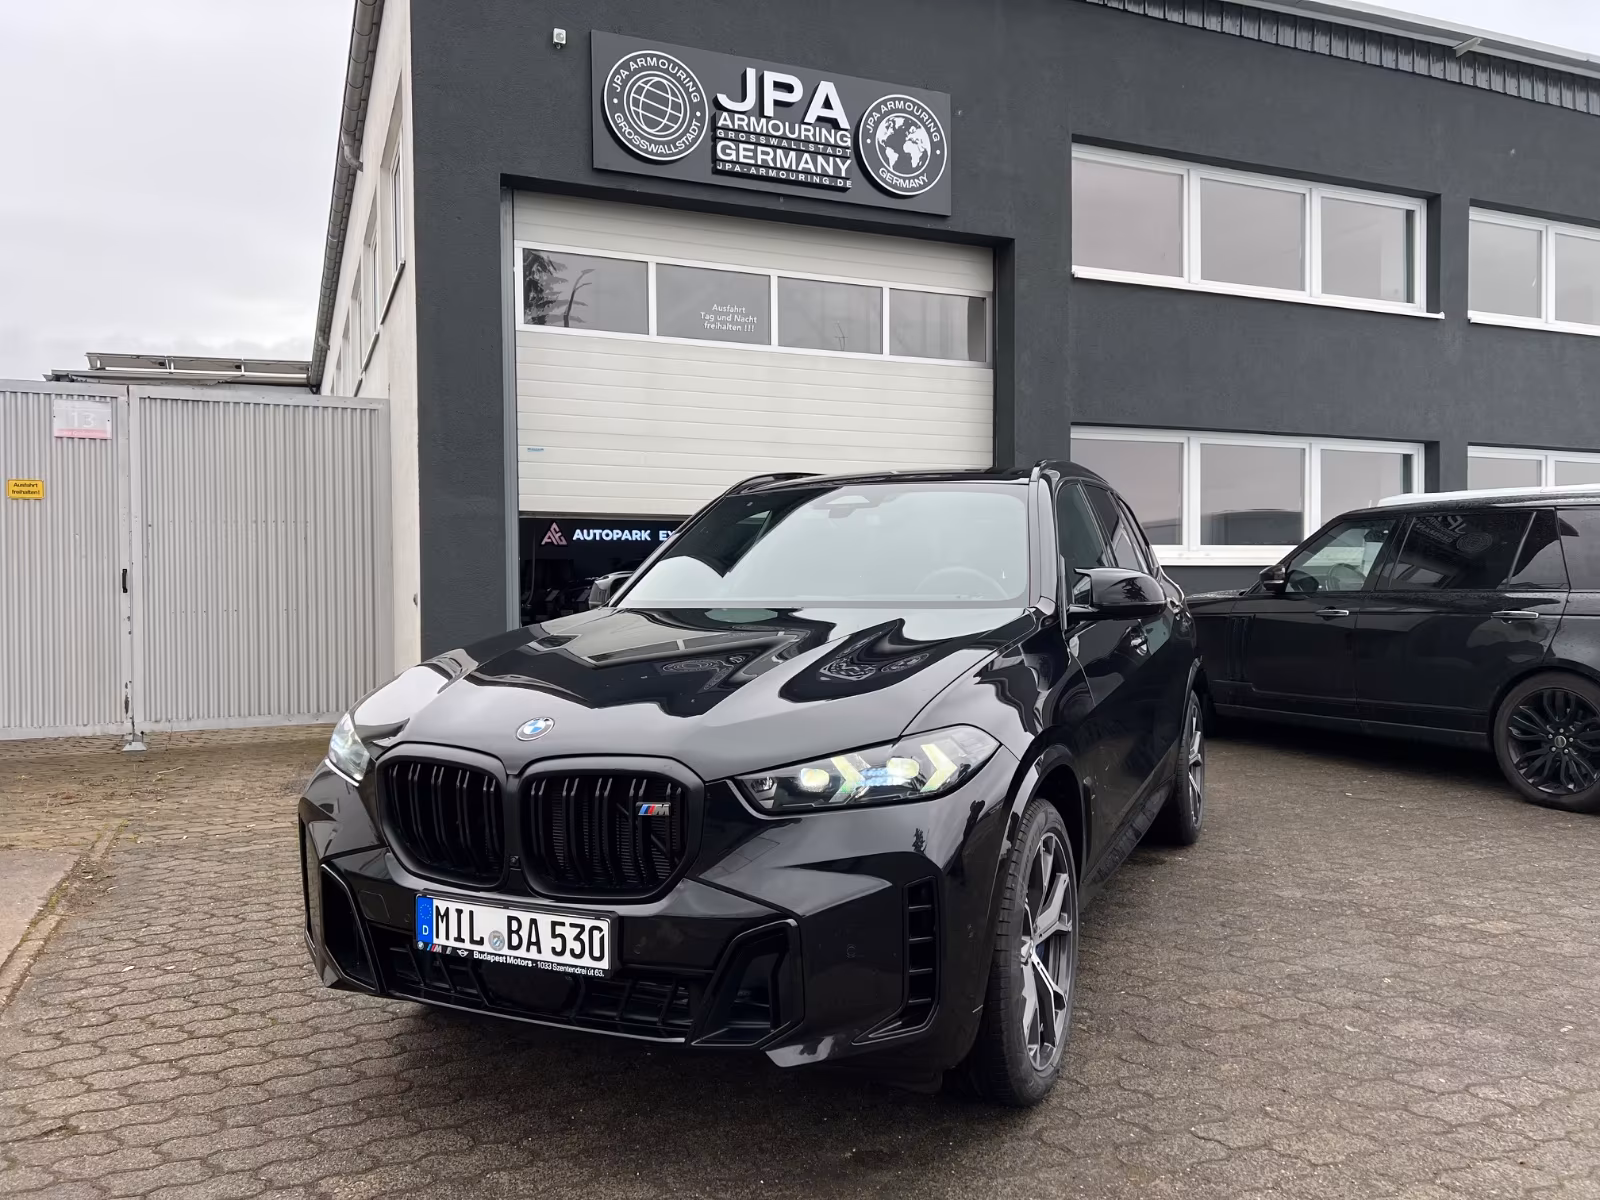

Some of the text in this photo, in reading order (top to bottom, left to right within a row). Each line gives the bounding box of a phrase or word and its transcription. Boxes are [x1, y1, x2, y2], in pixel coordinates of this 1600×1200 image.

[611, 56, 701, 103] JPA ARMOURING
[716, 67, 851, 130] JPA
[613, 111, 702, 154] GROSSWALLSTADT
[716, 111, 852, 147] ARMOURING
[866, 99, 941, 143] JPA ARMOURING
[716, 129, 852, 157] GROSSWALLSTADT
[716, 140, 852, 177] GERMANY
[716, 161, 853, 188] JPA-ARMOURING.DE
[878, 166, 929, 189] GERMANY
[700, 311, 757, 323] Tag und Nacht
[712, 303, 746, 314] Ausfahrt
[703, 321, 755, 332] freihalten !!!
[572, 529, 652, 541] AUTOPARK
[422, 925, 429, 935] D
[435, 905, 605, 962] MIL BA 530
[473, 951, 506, 963] Budapest
[507, 956, 532, 967] Motors
[537, 961, 552, 970] 1033
[552, 963, 587, 975] Szentendrei
[594, 969, 605, 977] 63.
